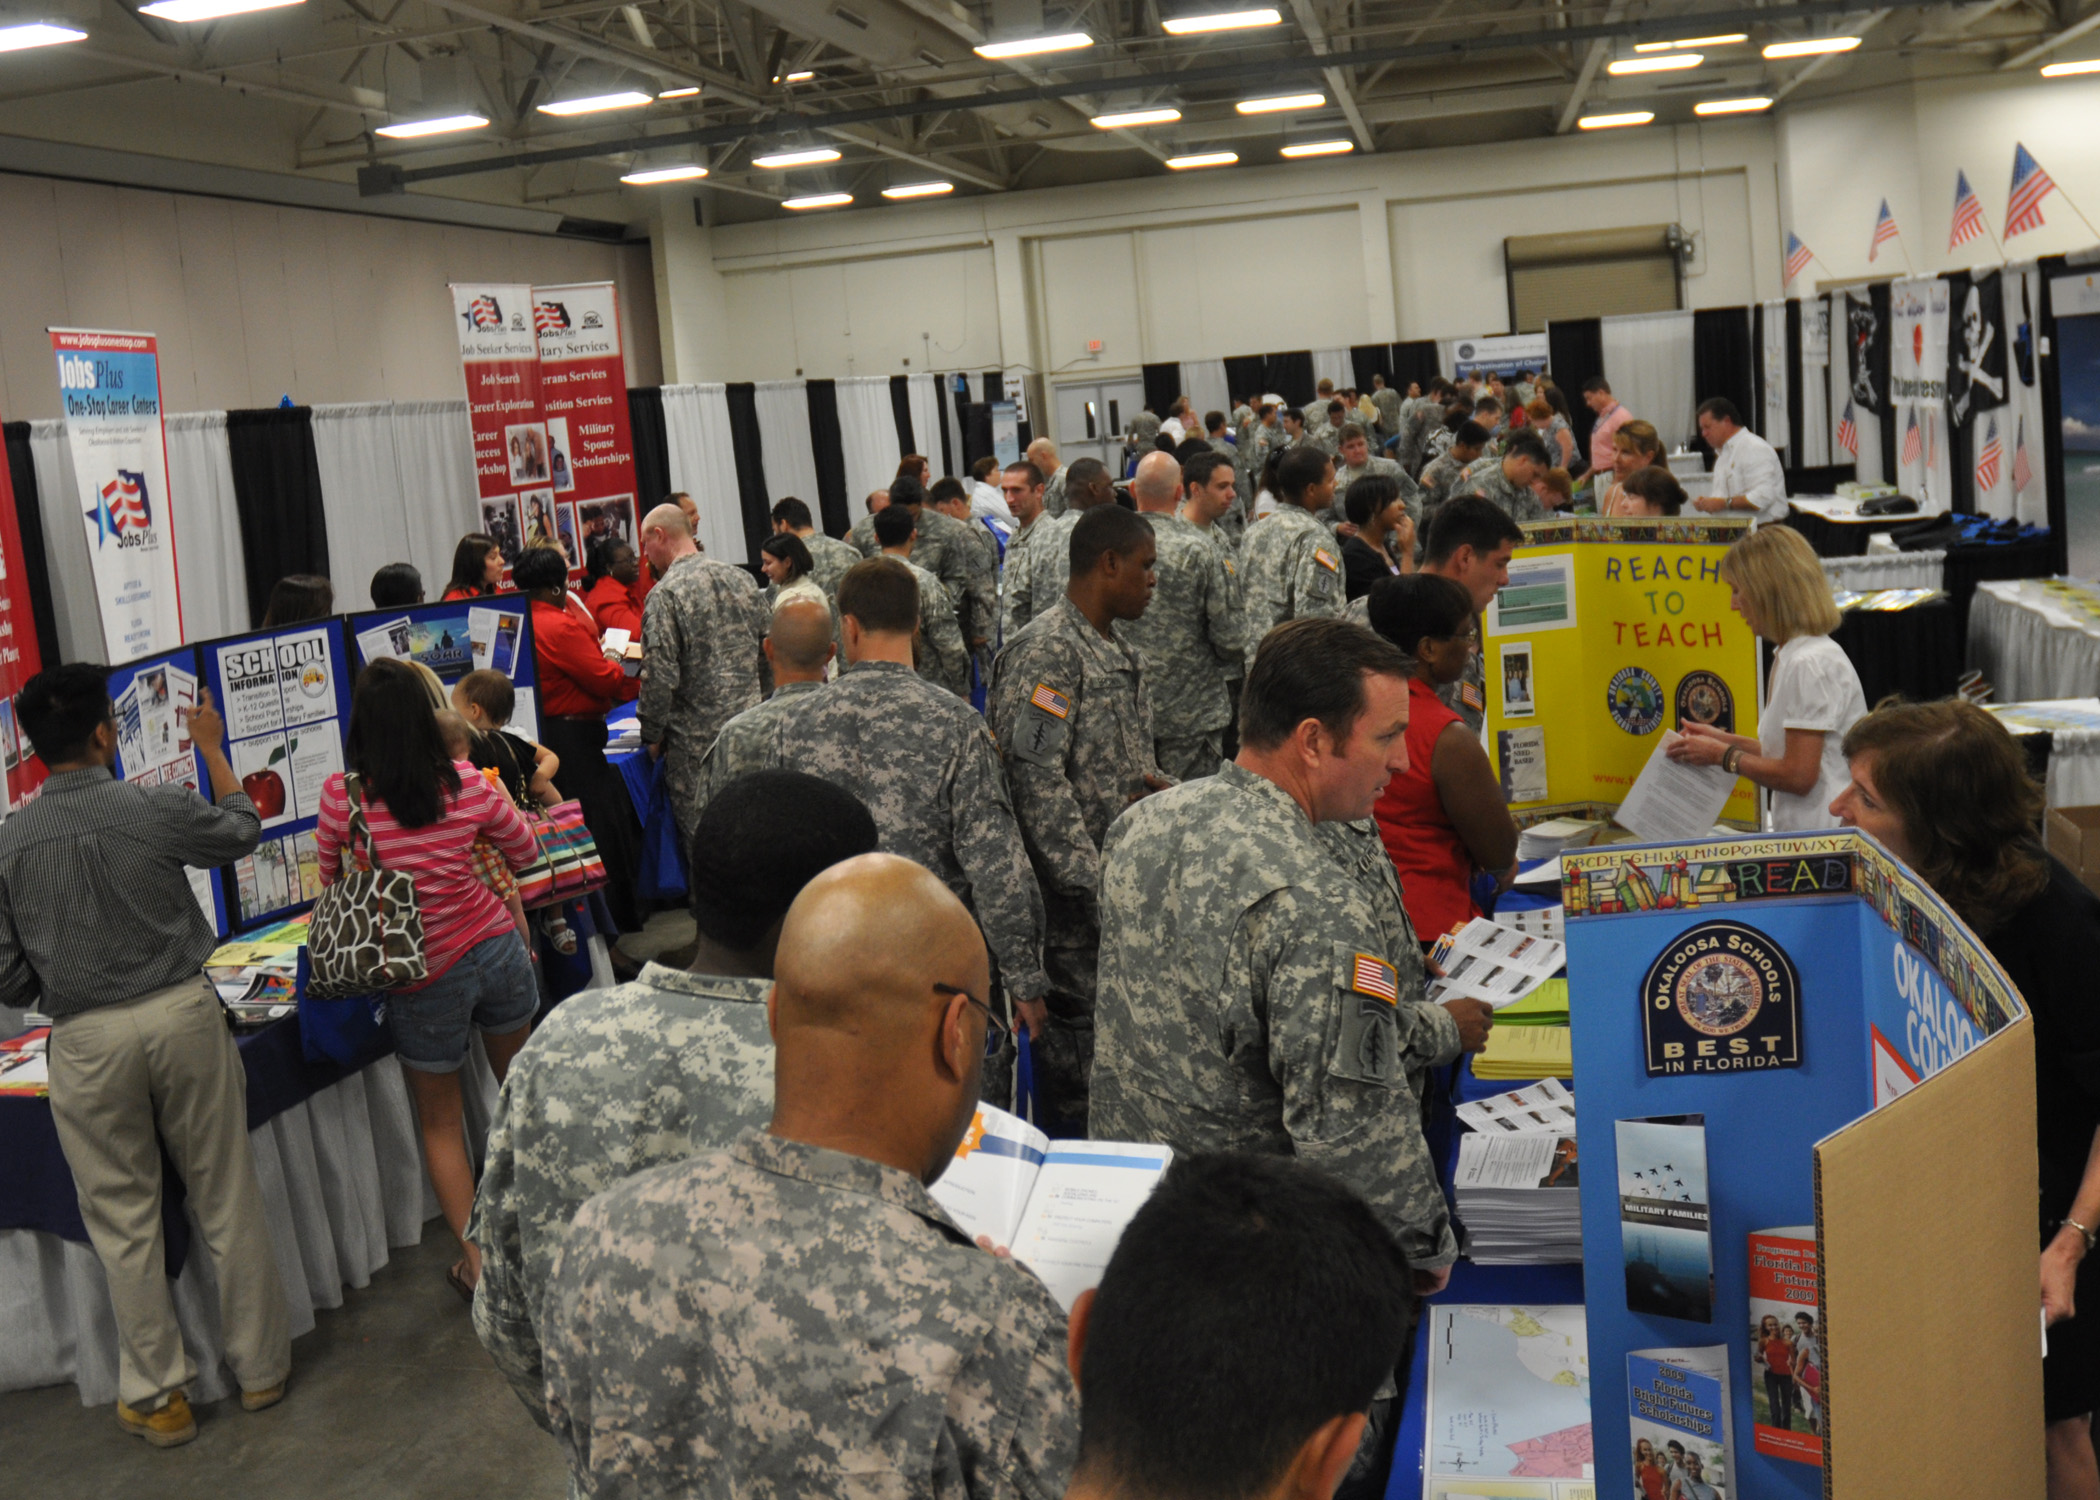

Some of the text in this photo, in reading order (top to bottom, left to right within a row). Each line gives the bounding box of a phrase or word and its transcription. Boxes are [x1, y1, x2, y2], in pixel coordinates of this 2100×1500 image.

[60, 335, 147, 350] www.jobsplusonestop.com
[462, 343, 532, 355] Job Seeker Services
[541, 340, 609, 358] tary Services
[481, 373, 520, 385] Job Search
[542, 369, 607, 385] erans Services
[68, 394, 157, 420] One-Stop Career Centers
[496, 398, 534, 413] Exploration
[545, 395, 613, 411] sition Services
[579, 423, 615, 436] Military
[475, 447, 501, 459] uccess
[583, 439, 614, 453] Spouse
[572, 451, 630, 468] Scholarships
[477, 463, 507, 476] orkshop
[1605, 555, 1721, 583] REACH
[1644, 591, 1685, 615] TO
[1613, 621, 1723, 648] TEACH
[226, 640, 324, 679] SCHOOL
[420, 648, 462, 663] SOAR
[245, 711, 265, 722] School
[246, 719, 270, 733] Support
[1513, 741, 1540, 749] FLORIDA
[1737, 859, 1847, 897] READ
[1655, 935, 1781, 1010] OKALOOSA SCHOOLS
[1680, 974, 1692, 988] SEAL
[1705, 956, 1719, 964] THE
[1724, 956, 1744, 967] STATE
[1894, 942, 1982, 1061] OKALOO
[1702, 1025, 1716, 1033] GOD
[1664, 1036, 1781, 1058] BEST
[1665, 1055, 1780, 1073] IN FLORIDA
[1624, 1204, 1708, 1220] MILITARY FAMILIES
[1754, 1255, 1817, 1274] Florida Br
[1774, 1272, 1818, 1288] Future
[1785, 1288, 1814, 1302] 2009
[1659, 1366, 1686, 1382] 2009
[1654, 1379, 1694, 1402] Florida
[1633, 1386, 1713, 1421] Bright Futures
[1639, 1402, 1712, 1434] Scholarships
